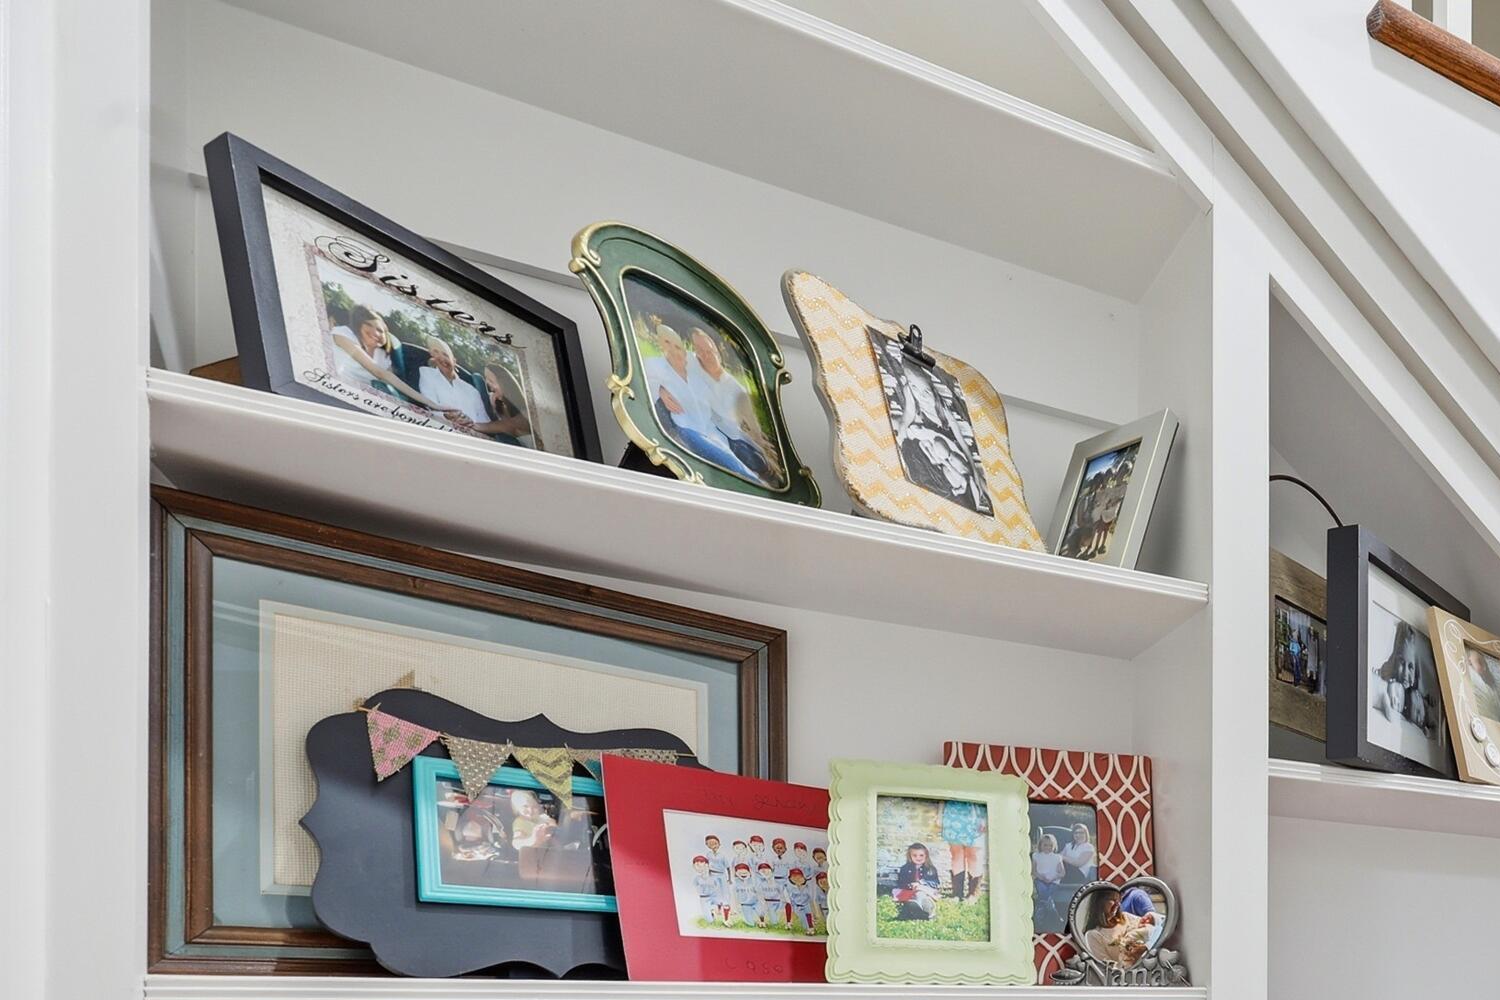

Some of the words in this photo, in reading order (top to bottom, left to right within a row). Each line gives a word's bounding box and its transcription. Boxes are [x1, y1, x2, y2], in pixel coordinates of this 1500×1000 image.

[313, 235, 528, 349] Sisters
[303, 368, 360, 403] Sisters
[1086, 959, 1169, 986] Nana
